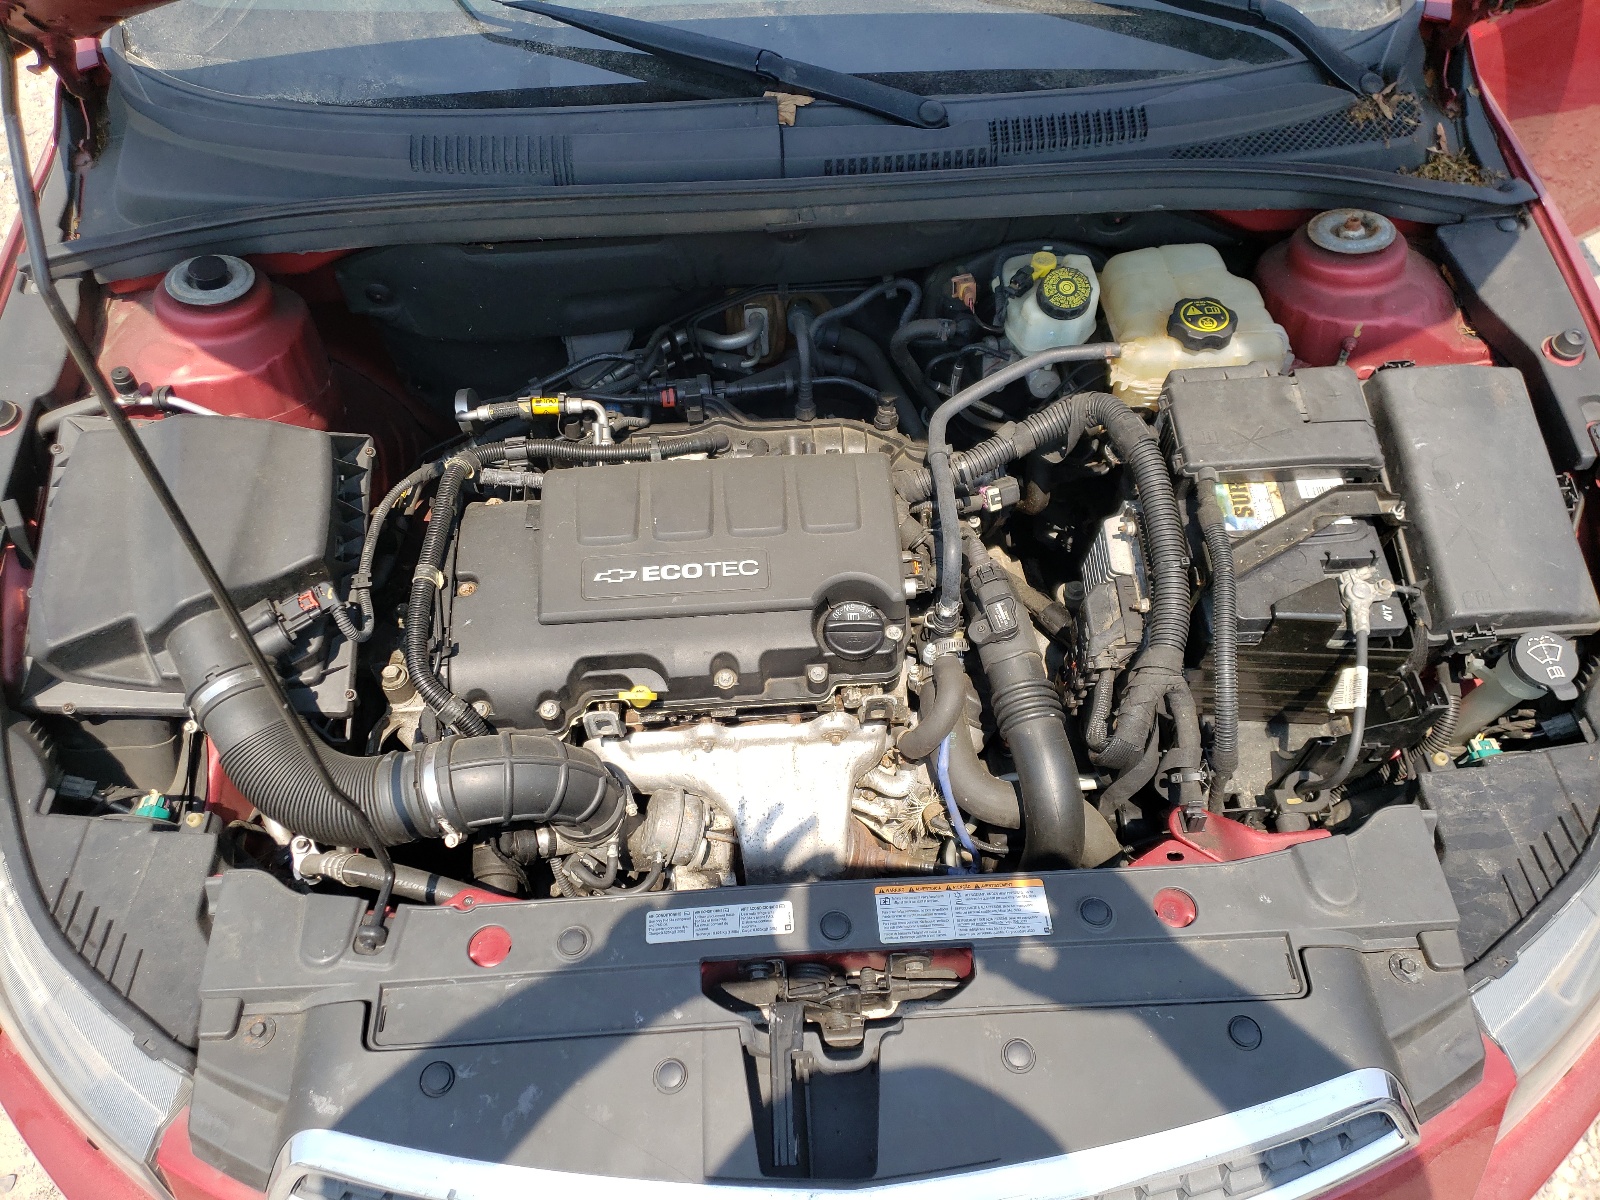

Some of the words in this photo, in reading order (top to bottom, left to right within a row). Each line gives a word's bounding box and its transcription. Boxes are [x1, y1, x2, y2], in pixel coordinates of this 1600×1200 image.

[642, 560, 759, 582] ECOTEC
[833, 604, 855, 619] 5W-30
[860, 605, 875, 618] SAE
[394, 879, 437, 893] GOODYEA
